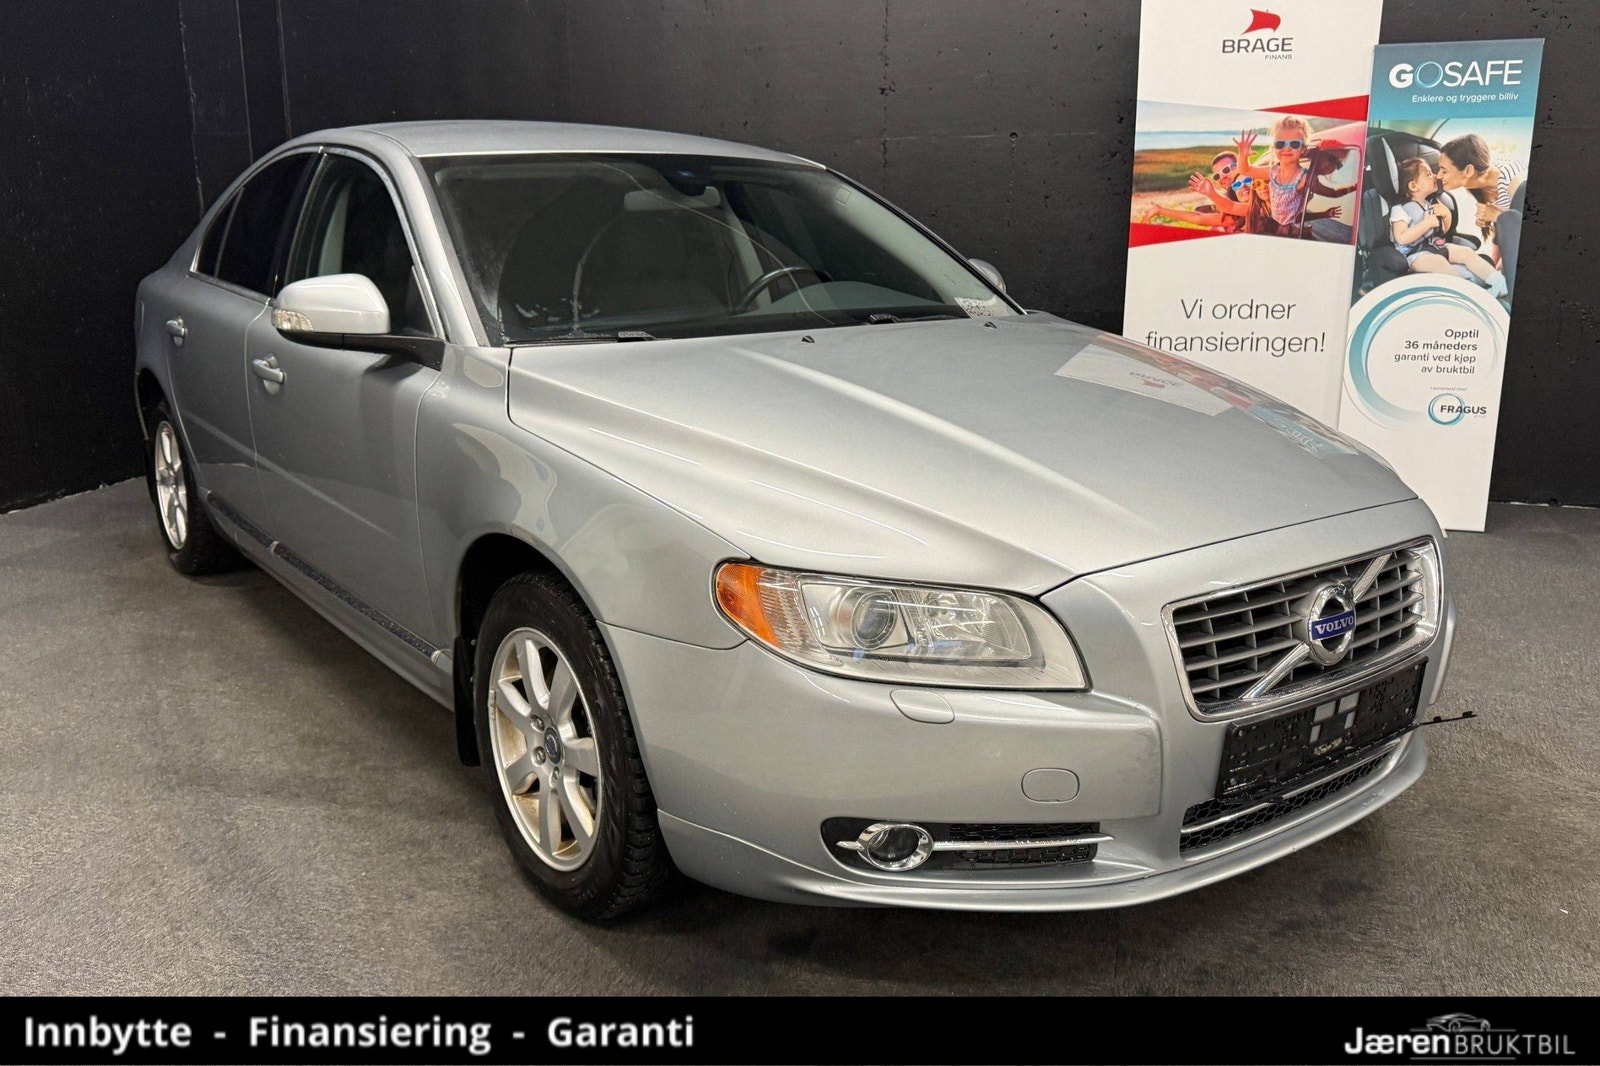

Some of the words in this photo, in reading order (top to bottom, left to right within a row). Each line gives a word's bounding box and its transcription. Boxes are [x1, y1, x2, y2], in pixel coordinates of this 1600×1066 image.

[1222, 37, 1294, 53] BRAGE
[1388, 59, 1523, 88] GOSAFE
[1412, 94, 1443, 102] Enklere
[1446, 95, 1457, 103] og
[1460, 94, 1496, 102] tryggere
[1499, 92, 1519, 100] billiv
[1180, 298, 1203, 320] Vi
[1211, 298, 1297, 320] ordner
[1444, 328, 1479, 339] Opptil
[1145, 331, 1326, 358] finansieringen!
[1404, 340, 1419, 349] 36
[1422, 340, 1477, 351] måneders
[1394, 353, 1430, 363] garanti
[1432, 353, 1451, 362] ved
[1454, 354, 1476, 364] kjøp
[1436, 365, 1475, 374] bruktbil
[1440, 404, 1487, 415] FRAGUS
[1314, 615, 1354, 635] VOLVO
